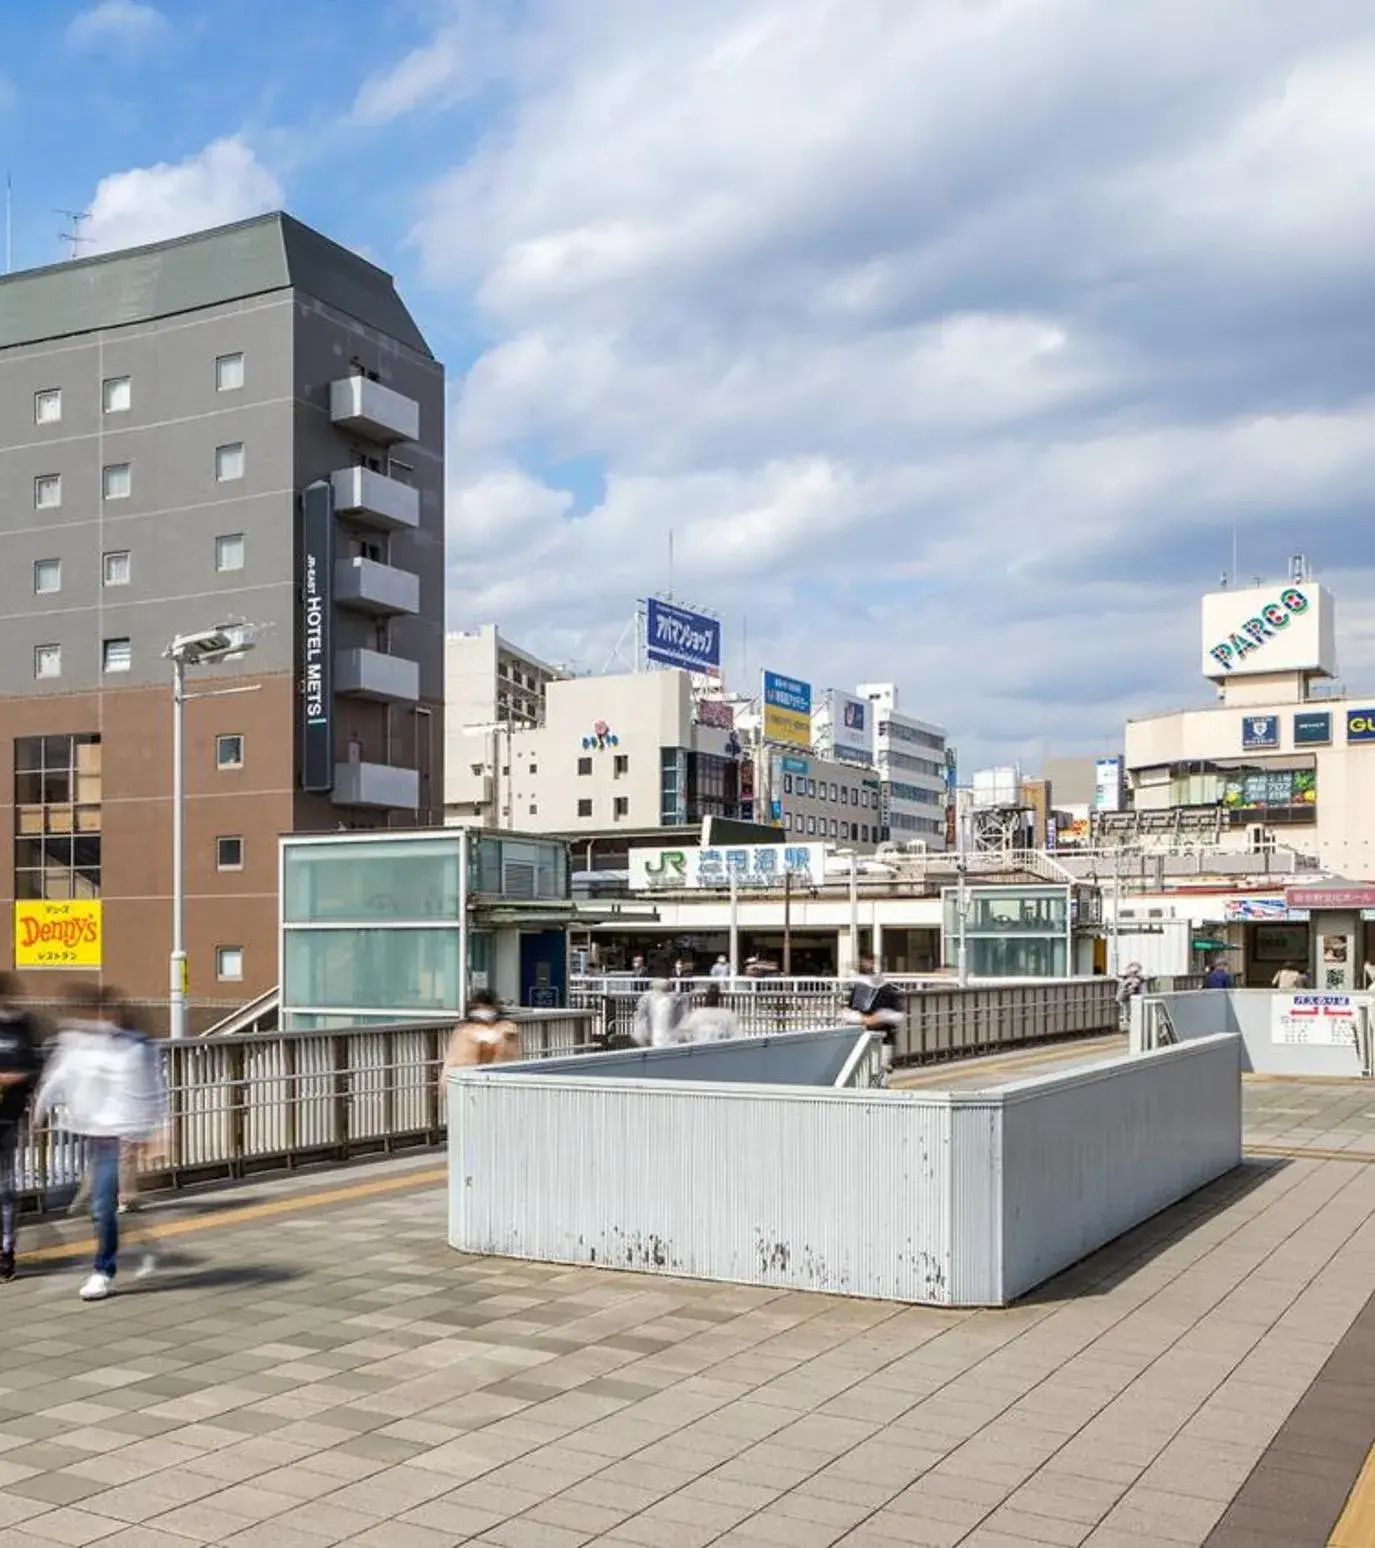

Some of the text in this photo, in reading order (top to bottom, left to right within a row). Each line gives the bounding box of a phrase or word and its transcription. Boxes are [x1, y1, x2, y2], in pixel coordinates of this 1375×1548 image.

[307, 597, 322, 662] HOTEL
[1210, 588, 1309, 670] PARCO
[307, 663, 322, 717] METS
[644, 850, 687, 875] JR
[19, 913, 98, 948] Denny's
